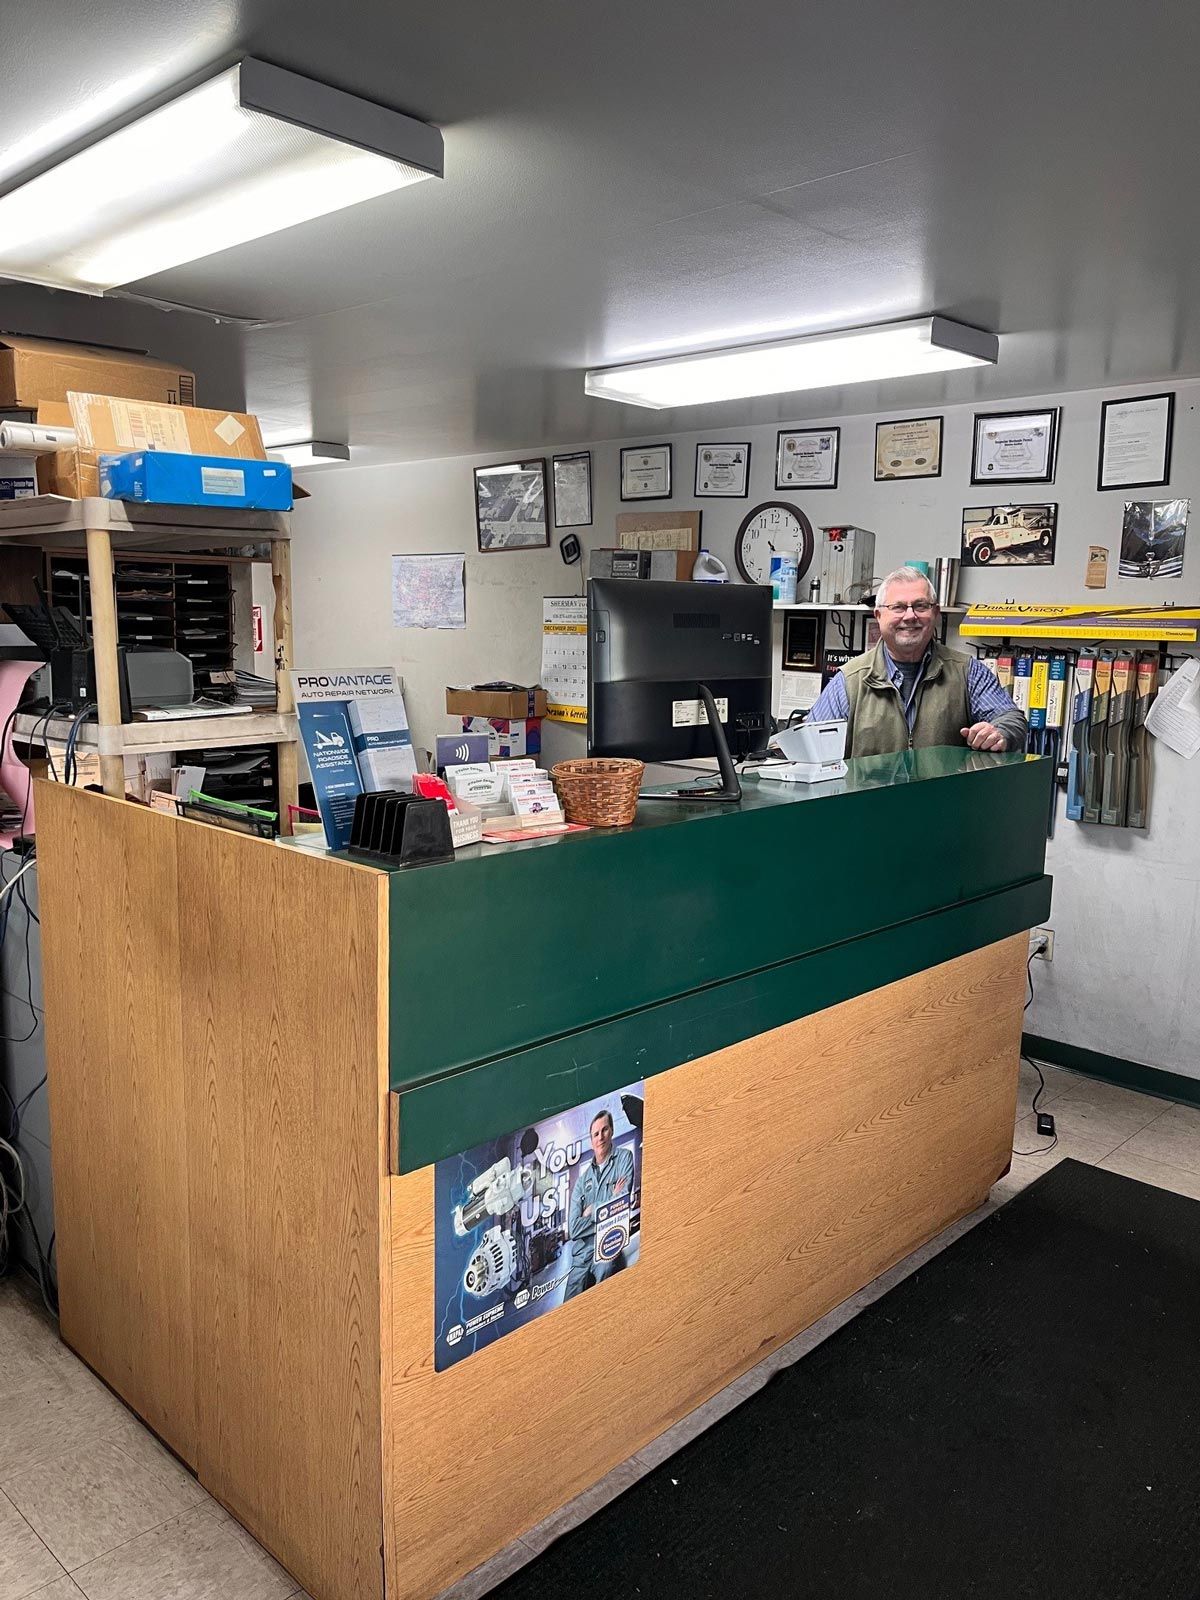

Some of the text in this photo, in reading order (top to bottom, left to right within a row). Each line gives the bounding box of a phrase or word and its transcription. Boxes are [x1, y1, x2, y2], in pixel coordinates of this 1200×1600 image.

[760, 518, 767, 528] 11
[771, 513, 780, 524] 12
[785, 516, 789, 527] 1
[751, 529, 760, 539] 10
[792, 527, 799, 538] 2
[746, 543, 751, 553] 9
[796, 542, 802, 553] 3
[827, 653, 838, 662] It's
[297, 674, 393, 688] PROVANTAGE
[355, 688, 395, 696] NETWORK
[313, 748, 350, 757] NATIONWIDE
[318, 754, 349, 762] ROADSIDE
[316, 760, 353, 769] ASSISTANCE
[453, 815, 479, 828] THANK YOU
[453, 830, 479, 843] BUSINESS
[531, 1279, 556, 1300] Power
[466, 1315, 483, 1329] POWER
[482, 1304, 504, 1320] SUPREME
